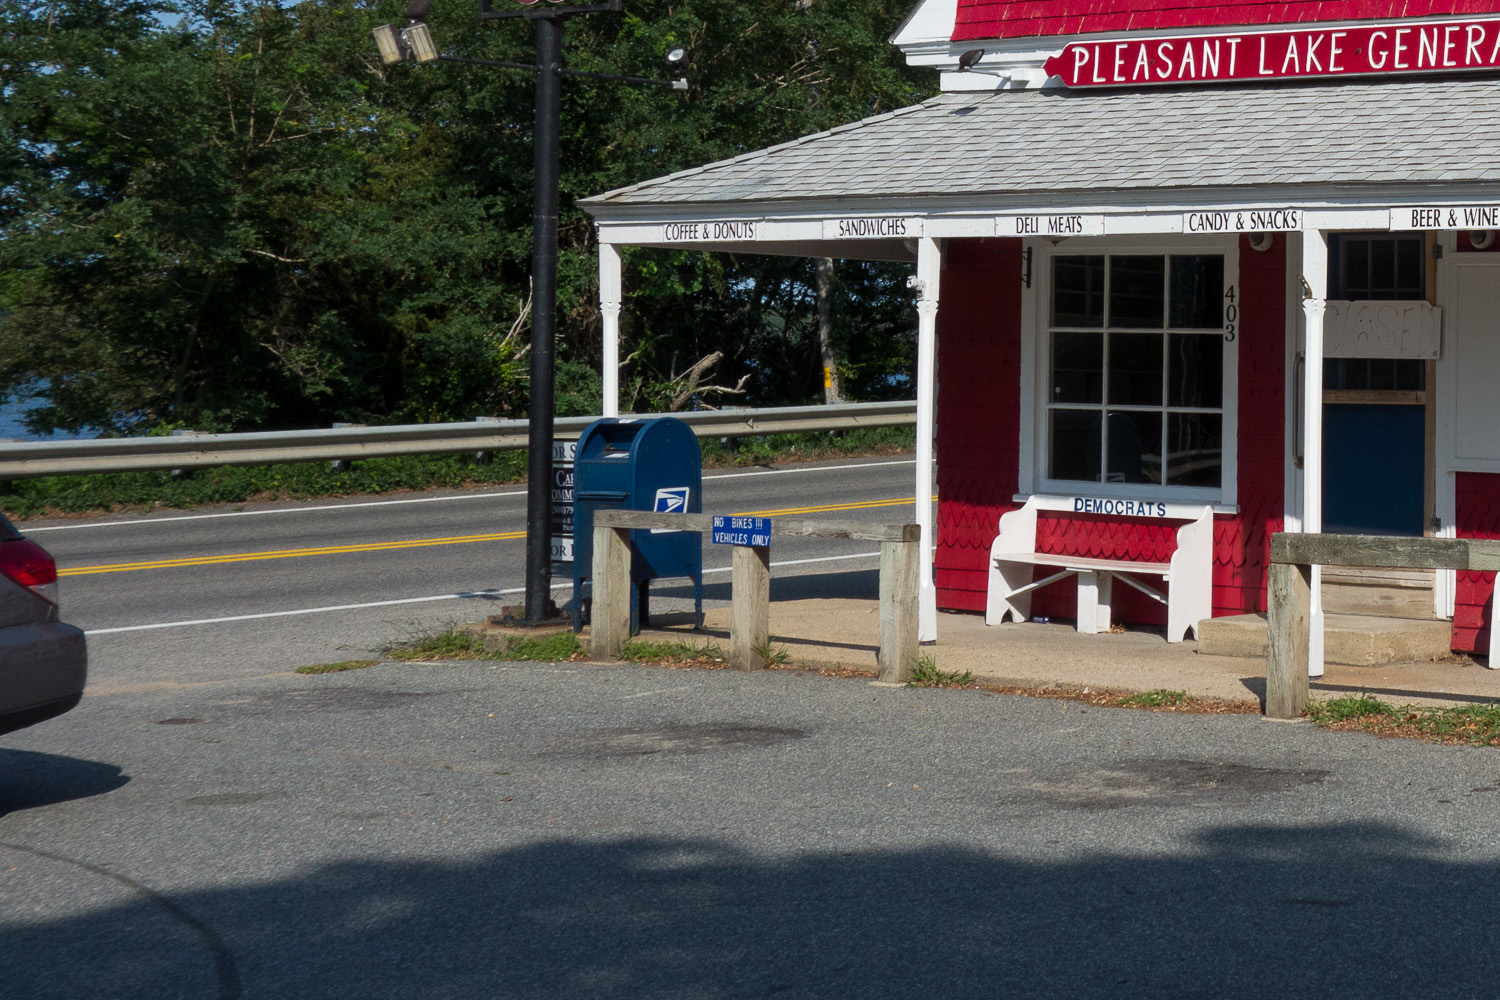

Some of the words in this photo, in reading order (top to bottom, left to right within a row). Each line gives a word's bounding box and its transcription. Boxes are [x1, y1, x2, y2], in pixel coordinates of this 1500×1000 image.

[1071, 38, 1241, 83] PLEASANT
[1259, 32, 1347, 75] LAKE
[1016, 216, 1039, 234] DELI
[1048, 215, 1083, 233] MEATS
[1189, 212, 1230, 231] CANDY
[1236, 212, 1245, 229] &
[1250, 210, 1298, 229] SNACKS
[1411, 209, 1441, 227] BEER
[1448, 208, 1458, 227] &
[1464, 207, 1499, 226] WINE
[665, 224, 699, 240] COFFEE
[702, 223, 710, 239] &
[713, 222, 754, 239] DONUTS
[839, 218, 907, 237] SANDWICHES
[1074, 497, 1166, 517] DEMOCRATS
[714, 516, 725, 528] NO
[732, 518, 753, 529] BIKES
[715, 532, 748, 545] VEHICLES
[752, 534, 770, 546] ONLY
